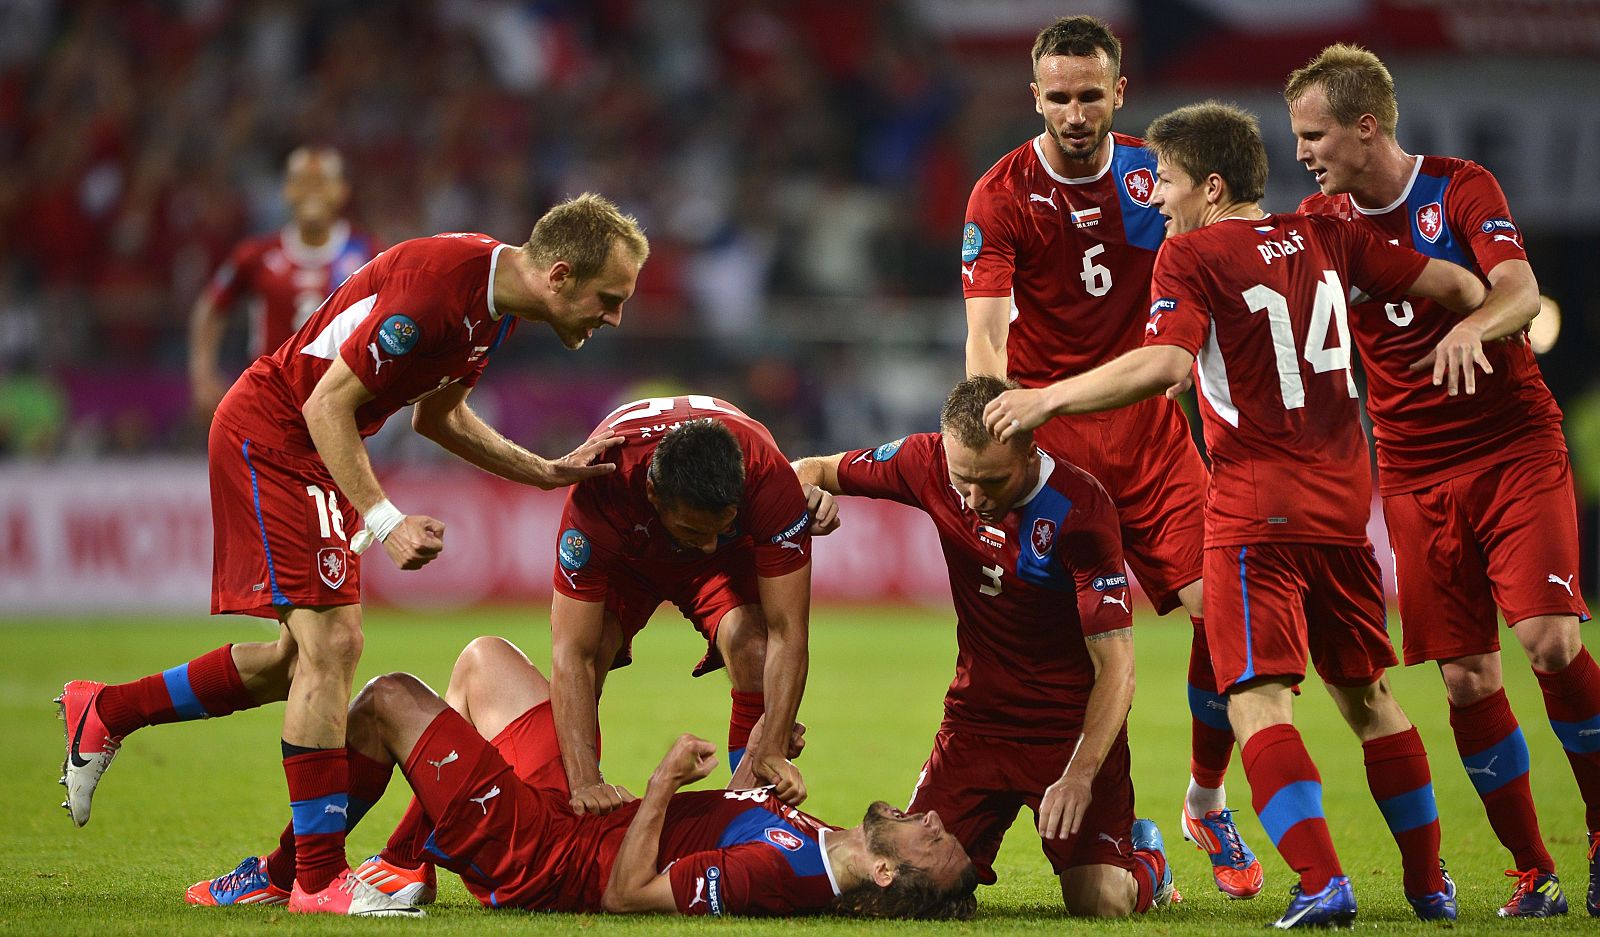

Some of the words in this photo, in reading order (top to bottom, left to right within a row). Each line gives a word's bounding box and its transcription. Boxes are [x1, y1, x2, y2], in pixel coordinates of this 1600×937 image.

[1080, 243, 1113, 297] 6
[1241, 270, 1359, 410] 14
[784, 513, 809, 539] RESPECT
[979, 564, 1005, 597] 3
[708, 880, 721, 916] RESPECT
